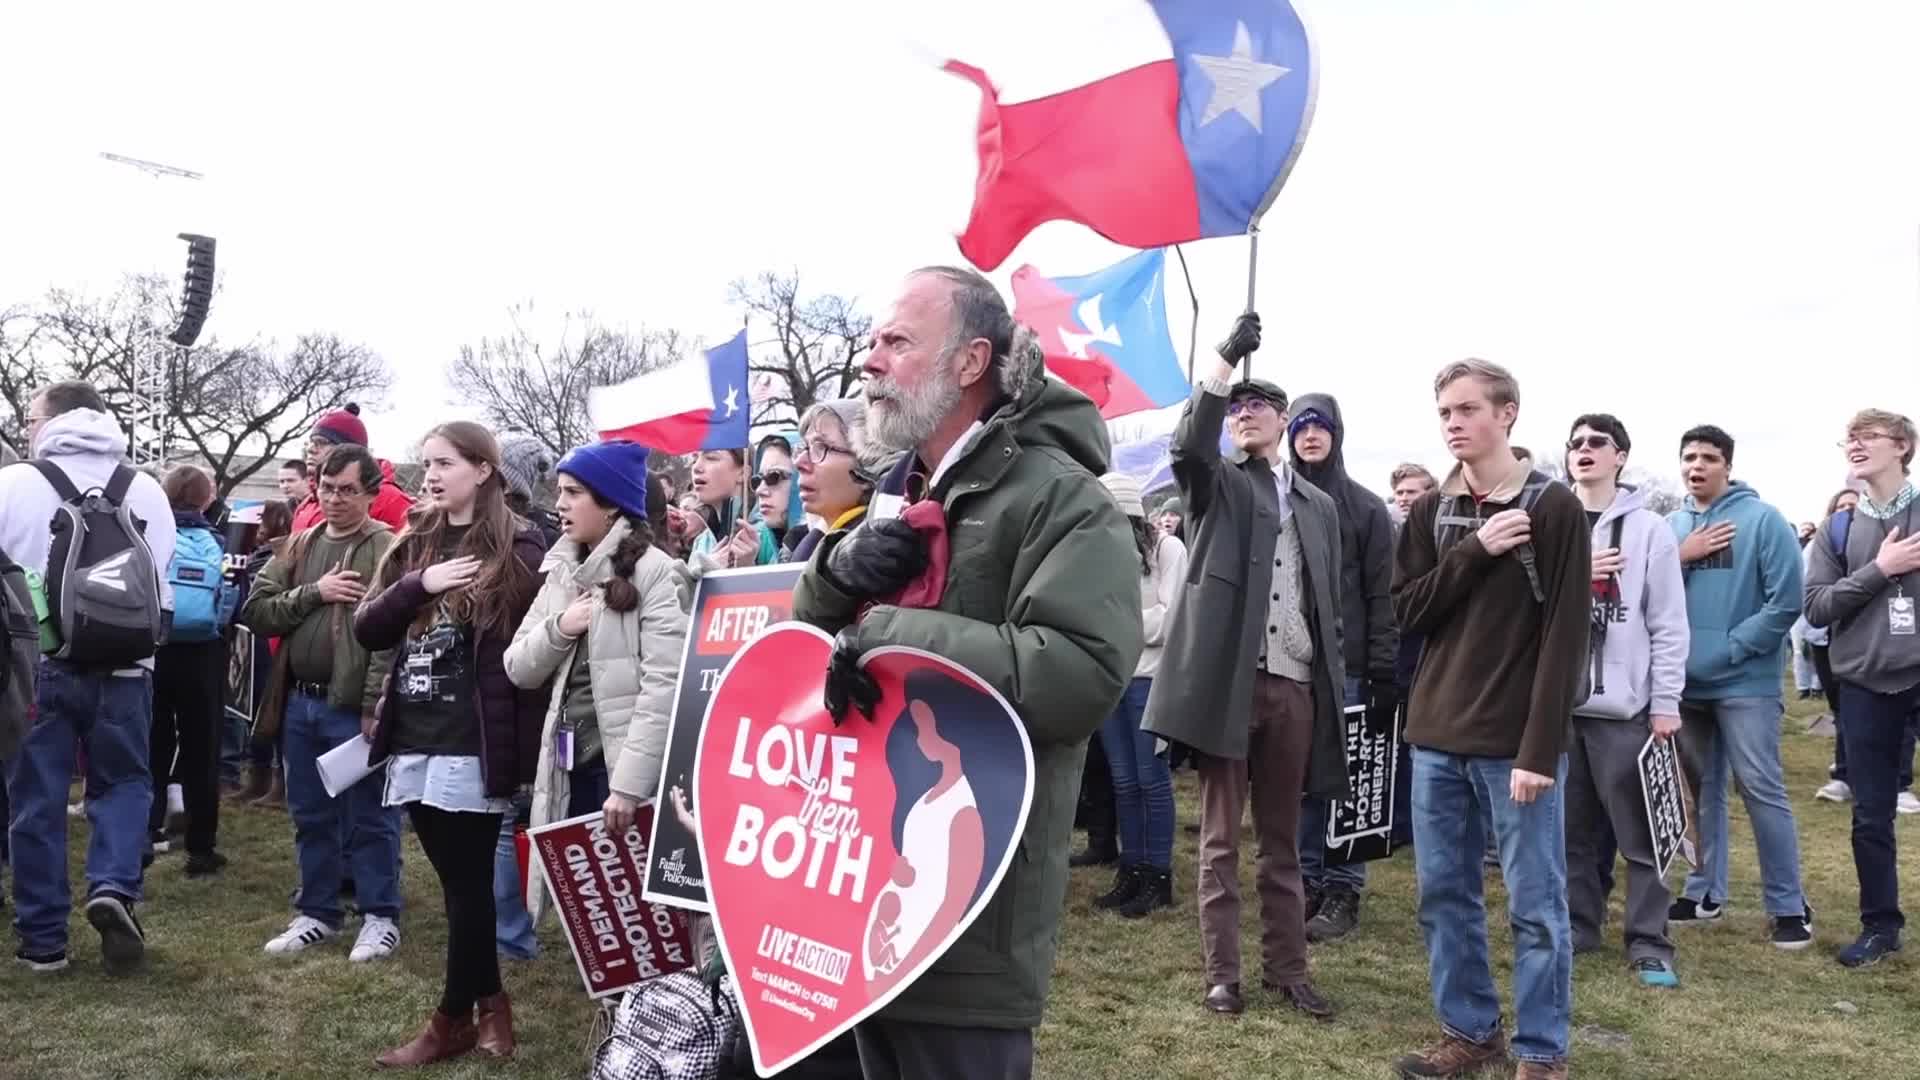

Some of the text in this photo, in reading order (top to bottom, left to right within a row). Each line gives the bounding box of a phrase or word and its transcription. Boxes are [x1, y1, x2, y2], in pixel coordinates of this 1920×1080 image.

[706, 606, 769, 641] AFTER
[728, 716, 858, 802] LOVE
[1347, 721, 1359, 766] THE
[785, 774, 861, 839] them
[659, 857, 685, 874] Family
[724, 803, 873, 903] BOTH
[564, 843, 621, 953] DEMAND
[585, 819, 662, 979] PROTECTION
[663, 871, 687, 887] Policy
[662, 941, 686, 964] AT
[757, 923, 850, 981] LIVE ACTION
[768, 973, 802, 996] MARCH
[801, 987, 811, 1000] to
